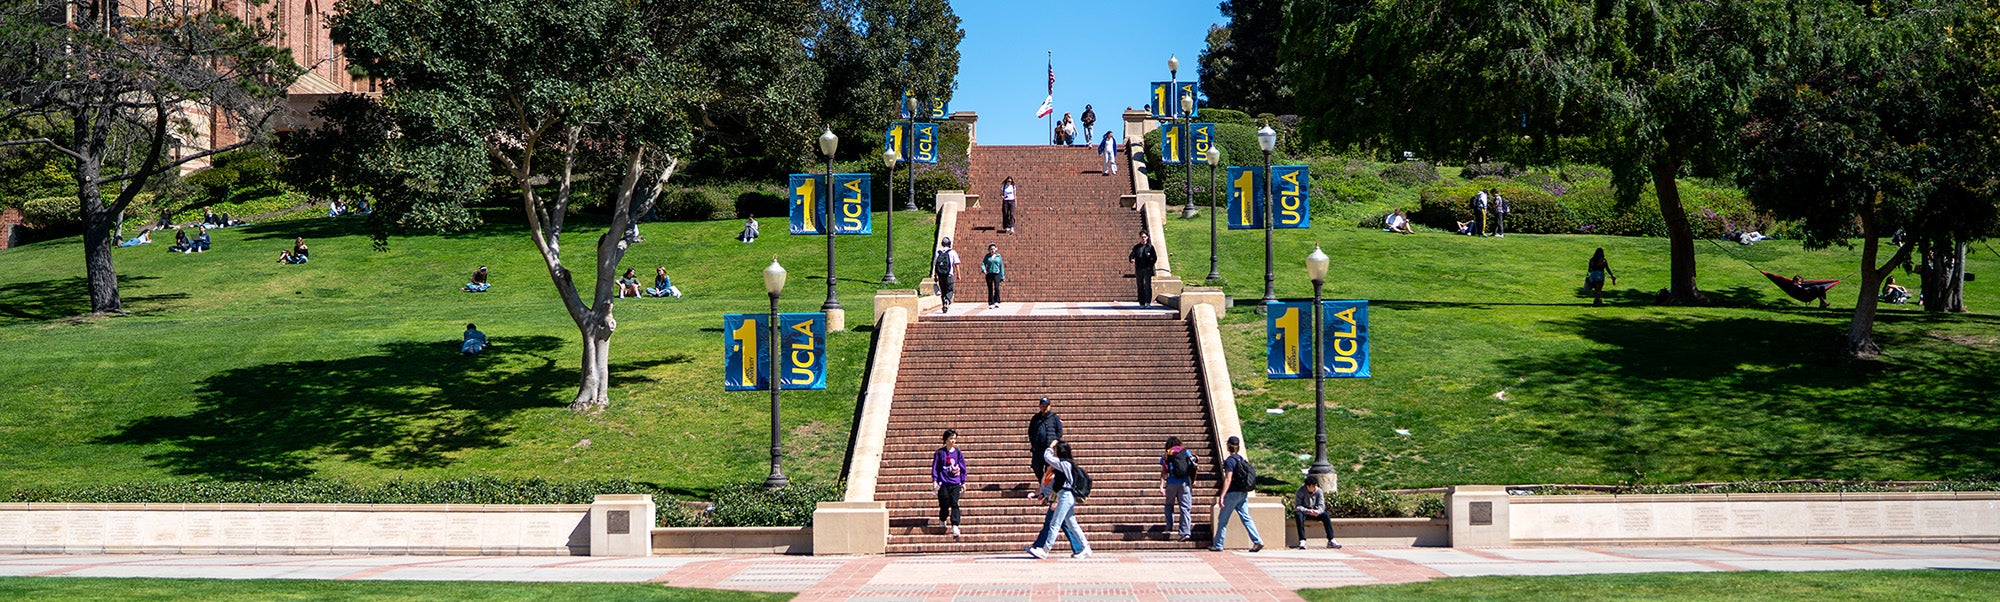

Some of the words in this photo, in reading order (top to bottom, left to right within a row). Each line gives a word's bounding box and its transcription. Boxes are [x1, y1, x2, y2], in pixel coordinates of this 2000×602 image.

[920, 127, 932, 160] UCLA
[1196, 126, 1209, 160] UCLA
[843, 178, 862, 231] UCLA
[1281, 170, 1300, 224] UCLA
[791, 319, 814, 385] UCLA
[1334, 307, 1358, 373] UCLA
